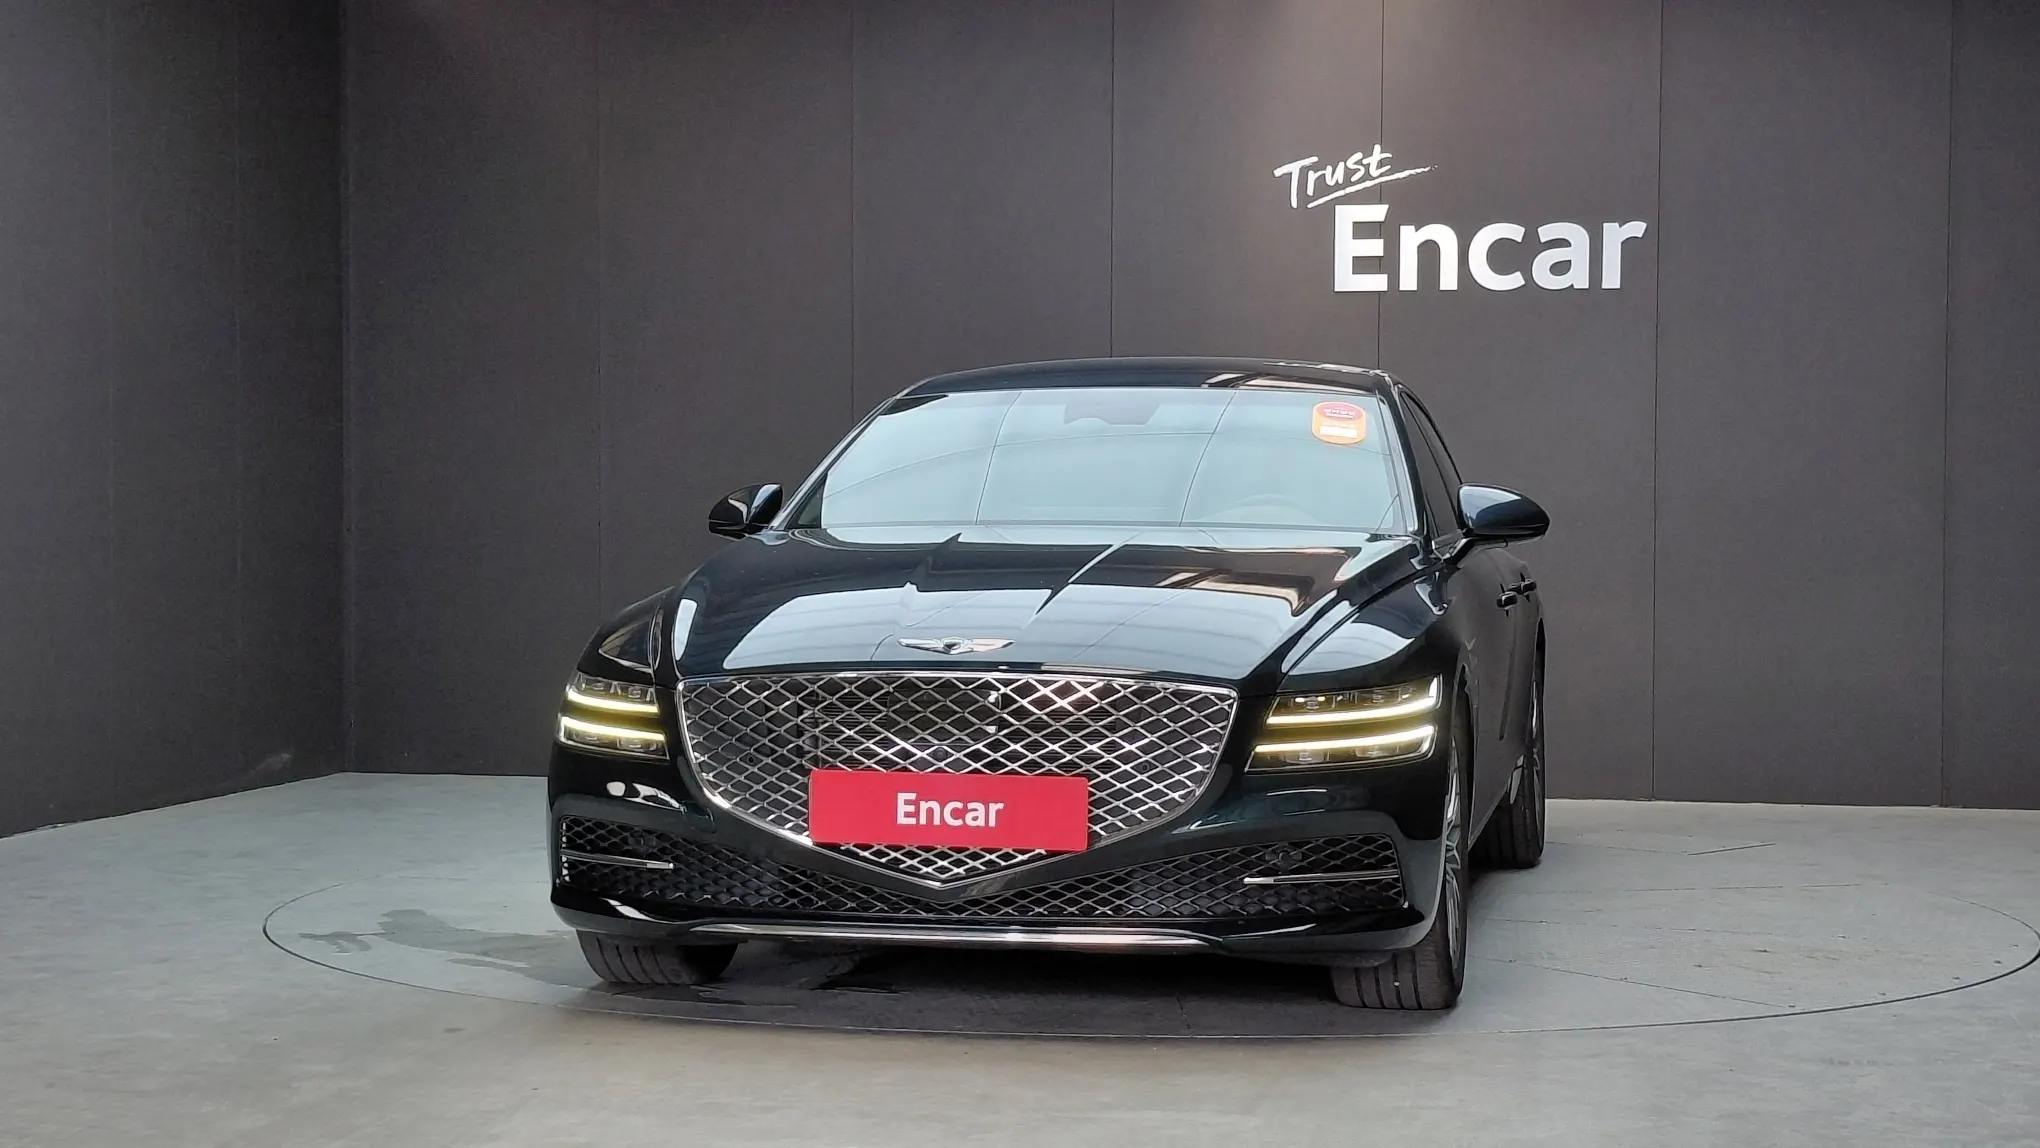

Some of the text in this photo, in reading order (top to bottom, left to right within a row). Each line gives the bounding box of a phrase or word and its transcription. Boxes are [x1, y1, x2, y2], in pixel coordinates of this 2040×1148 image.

[1273, 144, 1393, 209] Trust
[1333, 203, 1648, 293] Encar
[896, 792, 1004, 827] Encar
